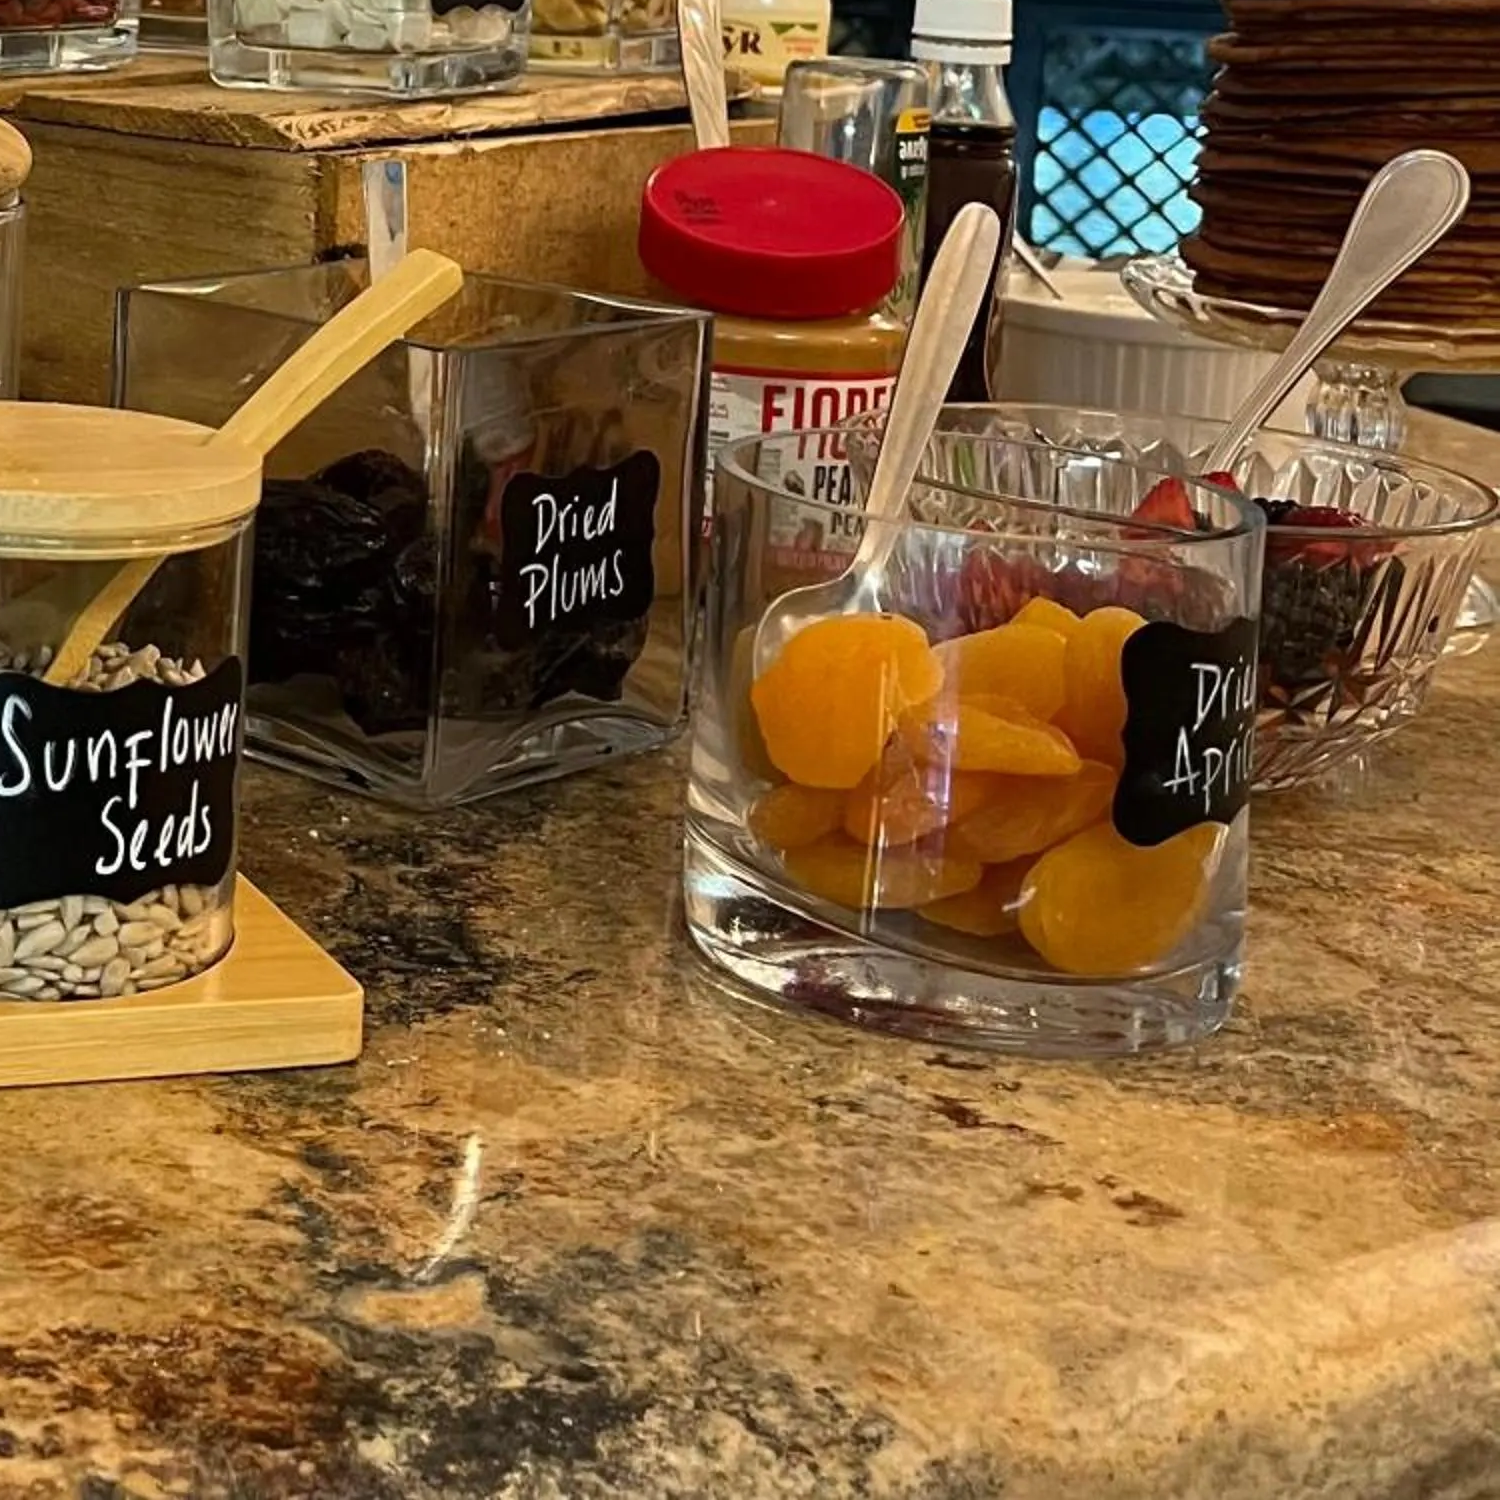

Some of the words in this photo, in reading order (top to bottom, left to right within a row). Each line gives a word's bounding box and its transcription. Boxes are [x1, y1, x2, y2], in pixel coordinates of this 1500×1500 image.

[532, 476, 618, 554] Dried
[519, 548, 624, 628] Plums
[95, 780, 211, 875] Seeds
